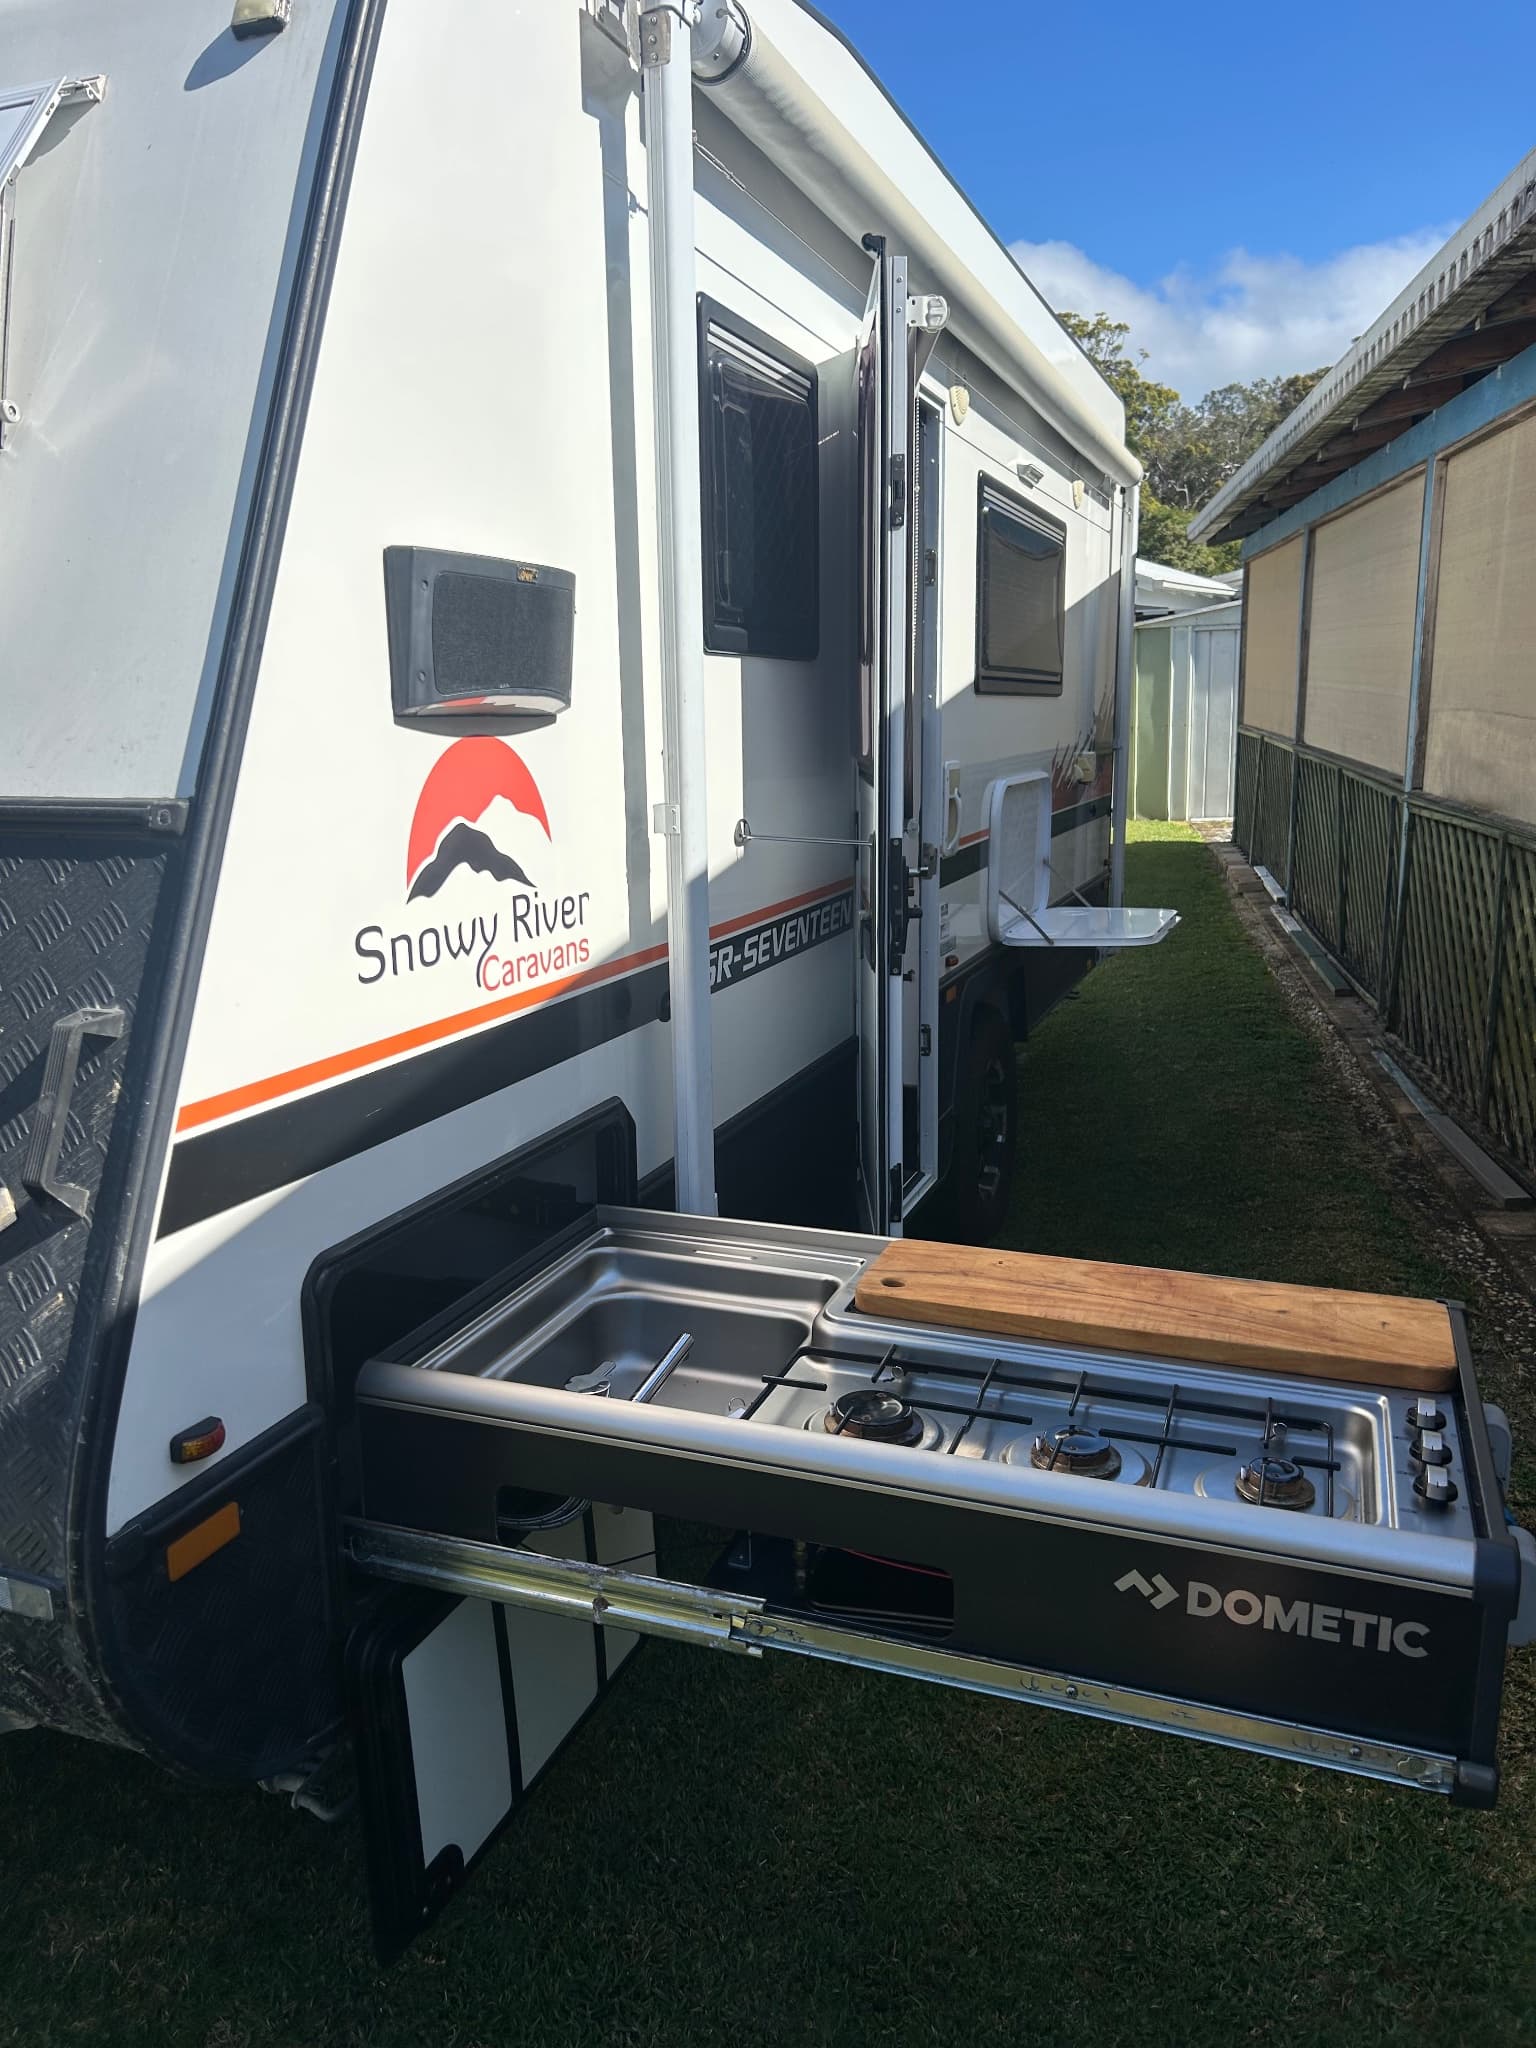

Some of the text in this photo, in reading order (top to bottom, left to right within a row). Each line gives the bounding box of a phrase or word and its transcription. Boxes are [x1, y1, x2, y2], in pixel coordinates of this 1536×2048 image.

[354, 891, 590, 988] Snowy River
[482, 938, 591, 992] Caravans
[1186, 1580, 1431, 1659] DOMETIC
